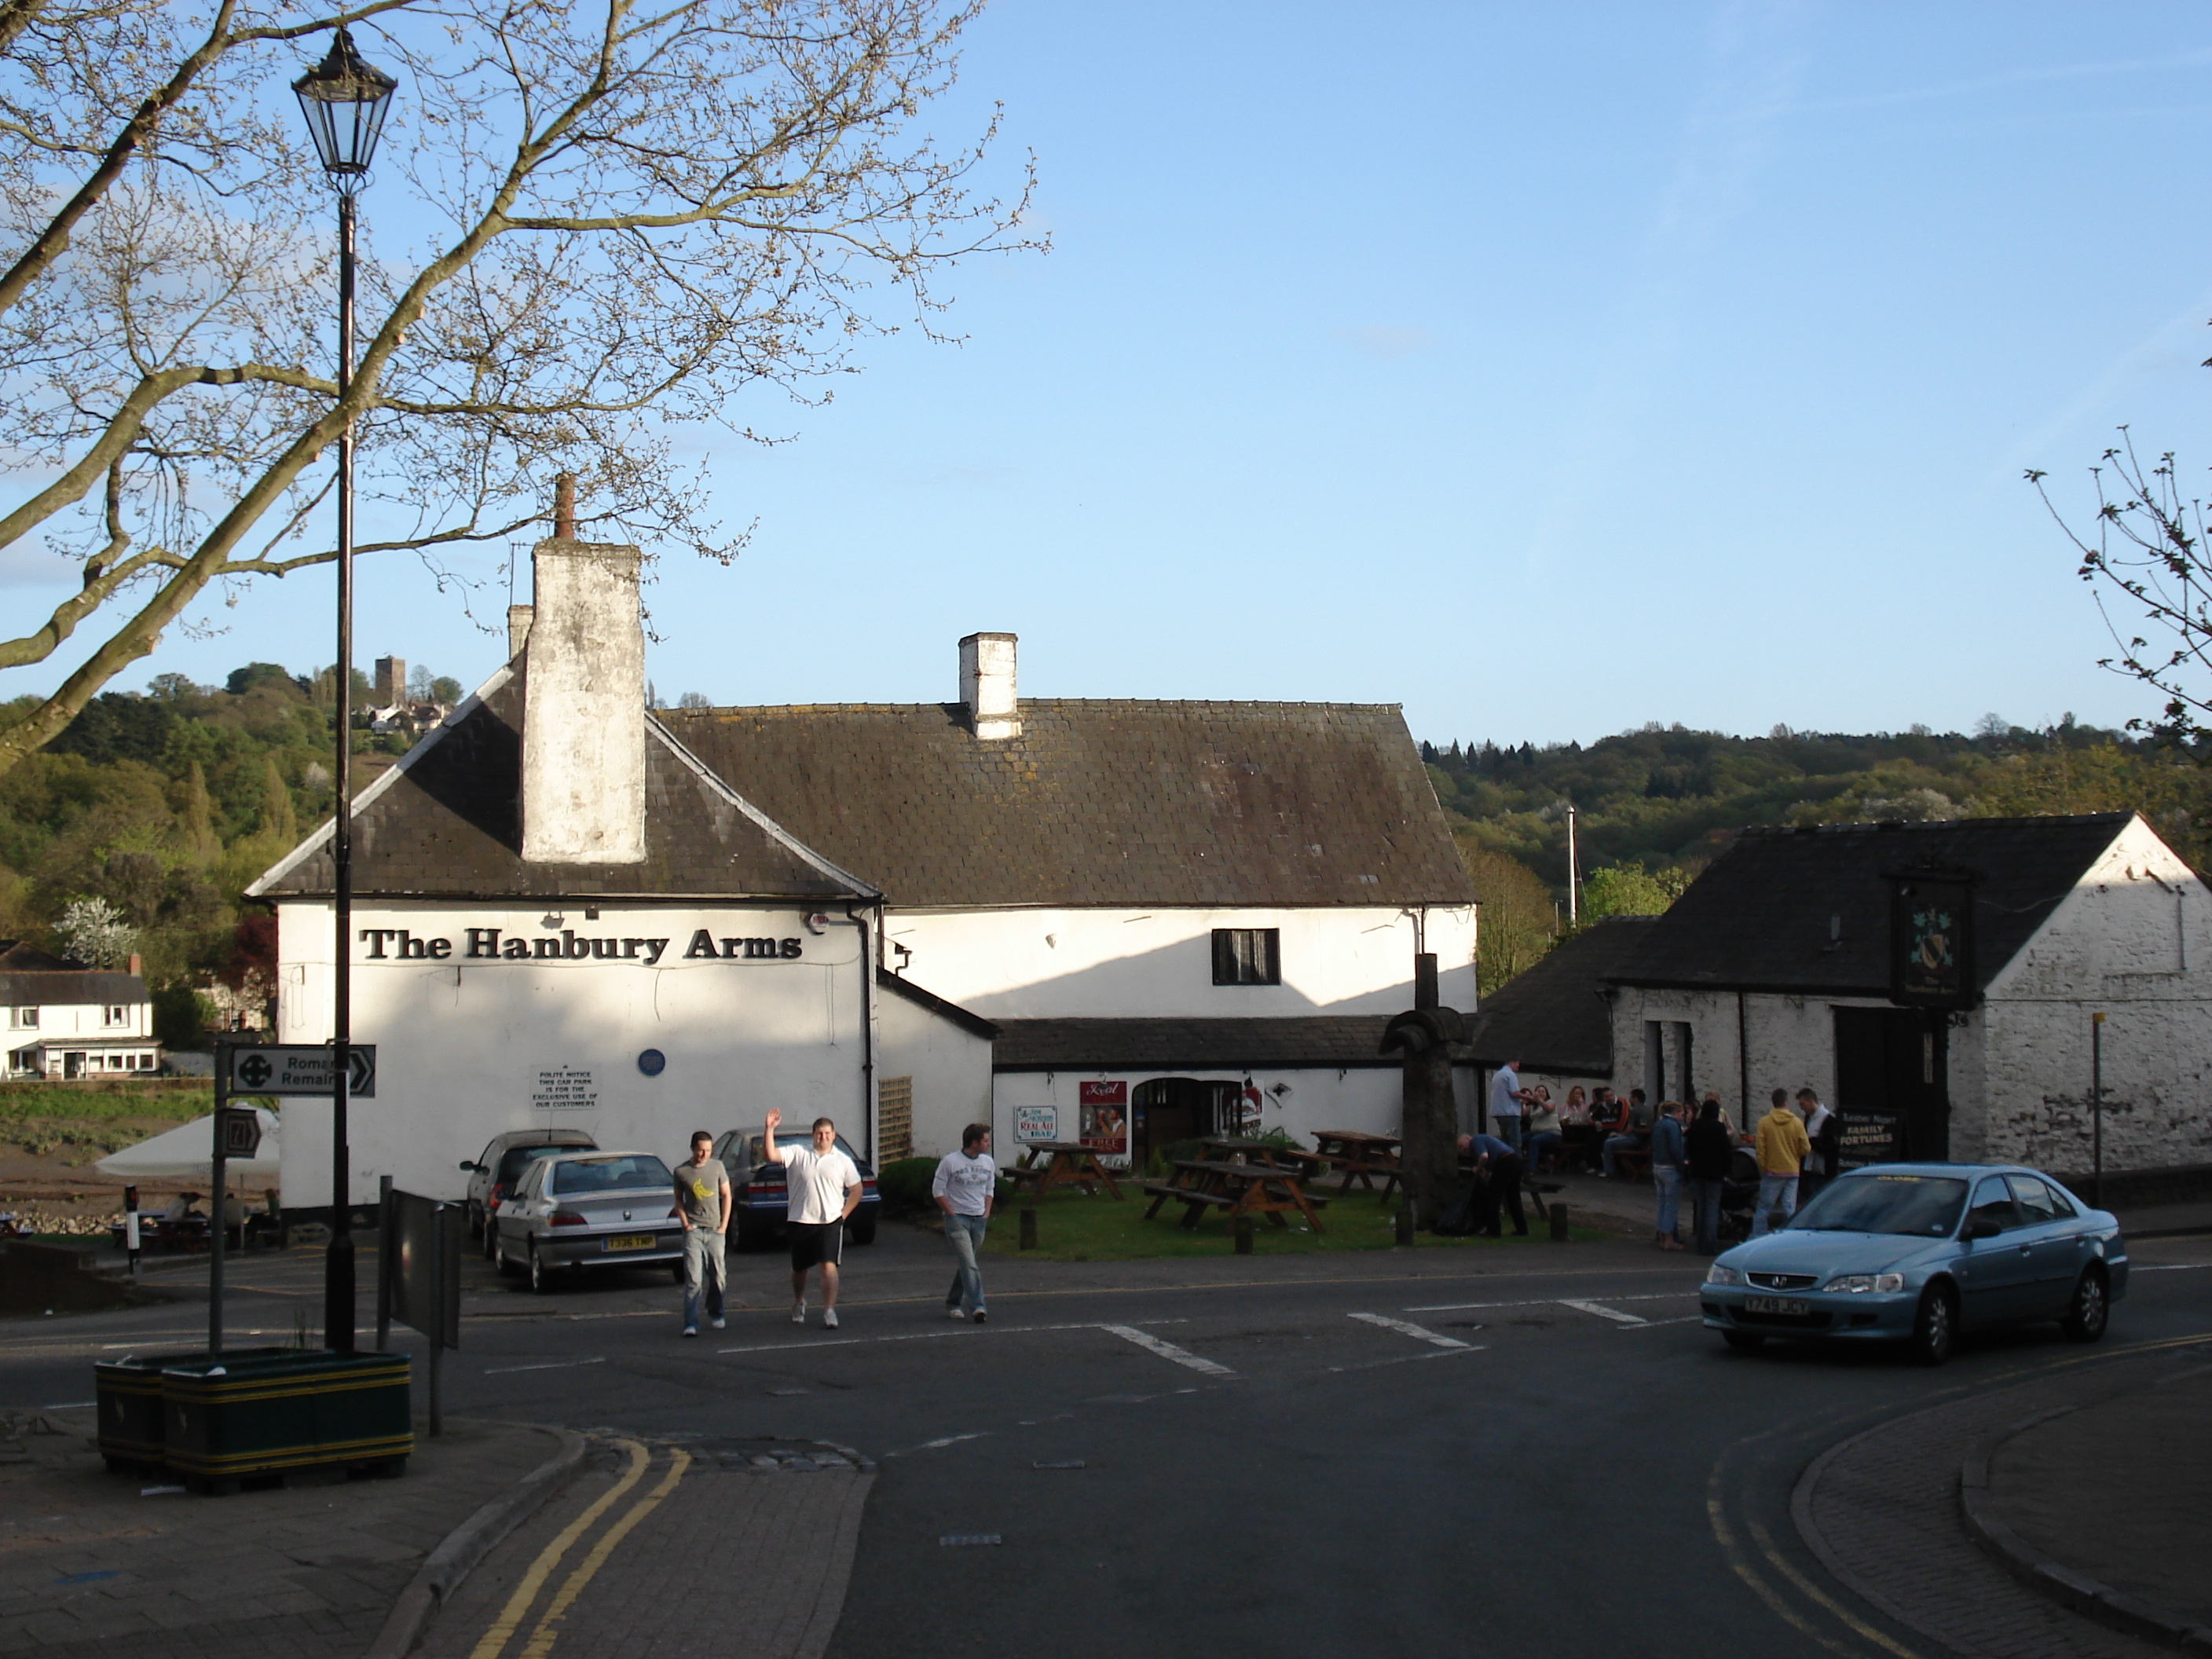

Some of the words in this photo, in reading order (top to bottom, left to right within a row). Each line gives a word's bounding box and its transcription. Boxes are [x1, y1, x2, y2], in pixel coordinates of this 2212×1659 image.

[359, 929, 451, 960] The
[464, 928, 668, 965] Hanbury
[683, 929, 802, 960] Arms
[1848, 1125, 1885, 1134] FAMILY
[1840, 1133, 1893, 1145] FORTUNES
